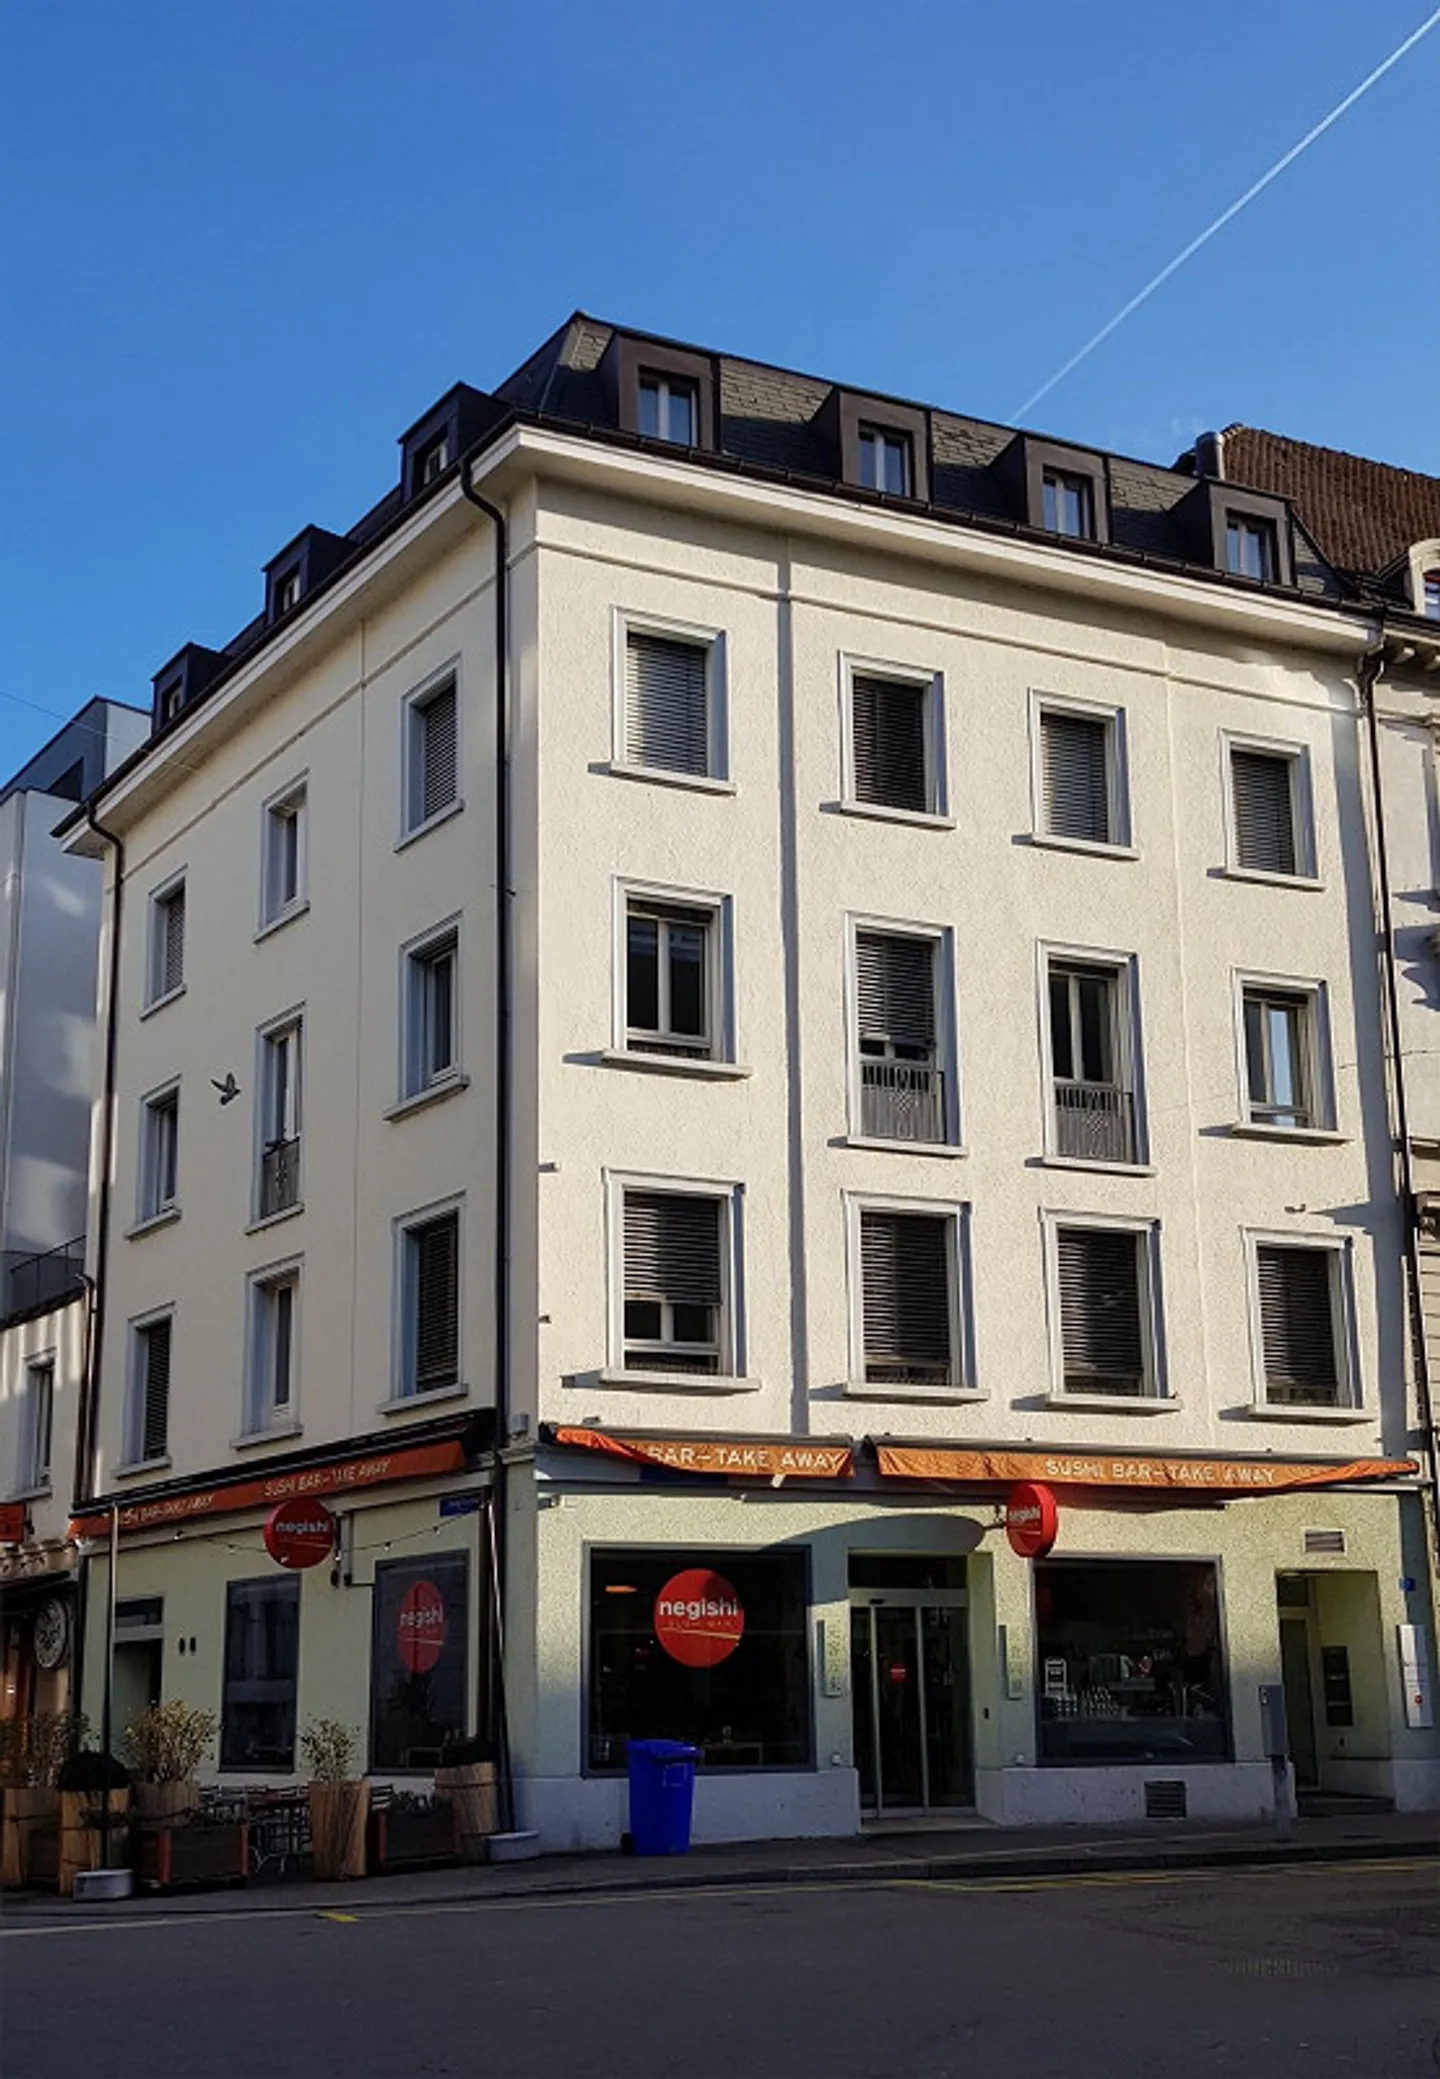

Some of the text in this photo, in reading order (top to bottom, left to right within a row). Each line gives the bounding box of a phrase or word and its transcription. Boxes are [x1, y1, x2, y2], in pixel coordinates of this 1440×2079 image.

[781, 1452, 842, 1469] AWAY
[1045, 1459, 1104, 1477] SUSHI
[1225, 1467, 1275, 1483] AWAY
[659, 1597, 738, 1621] negishi
